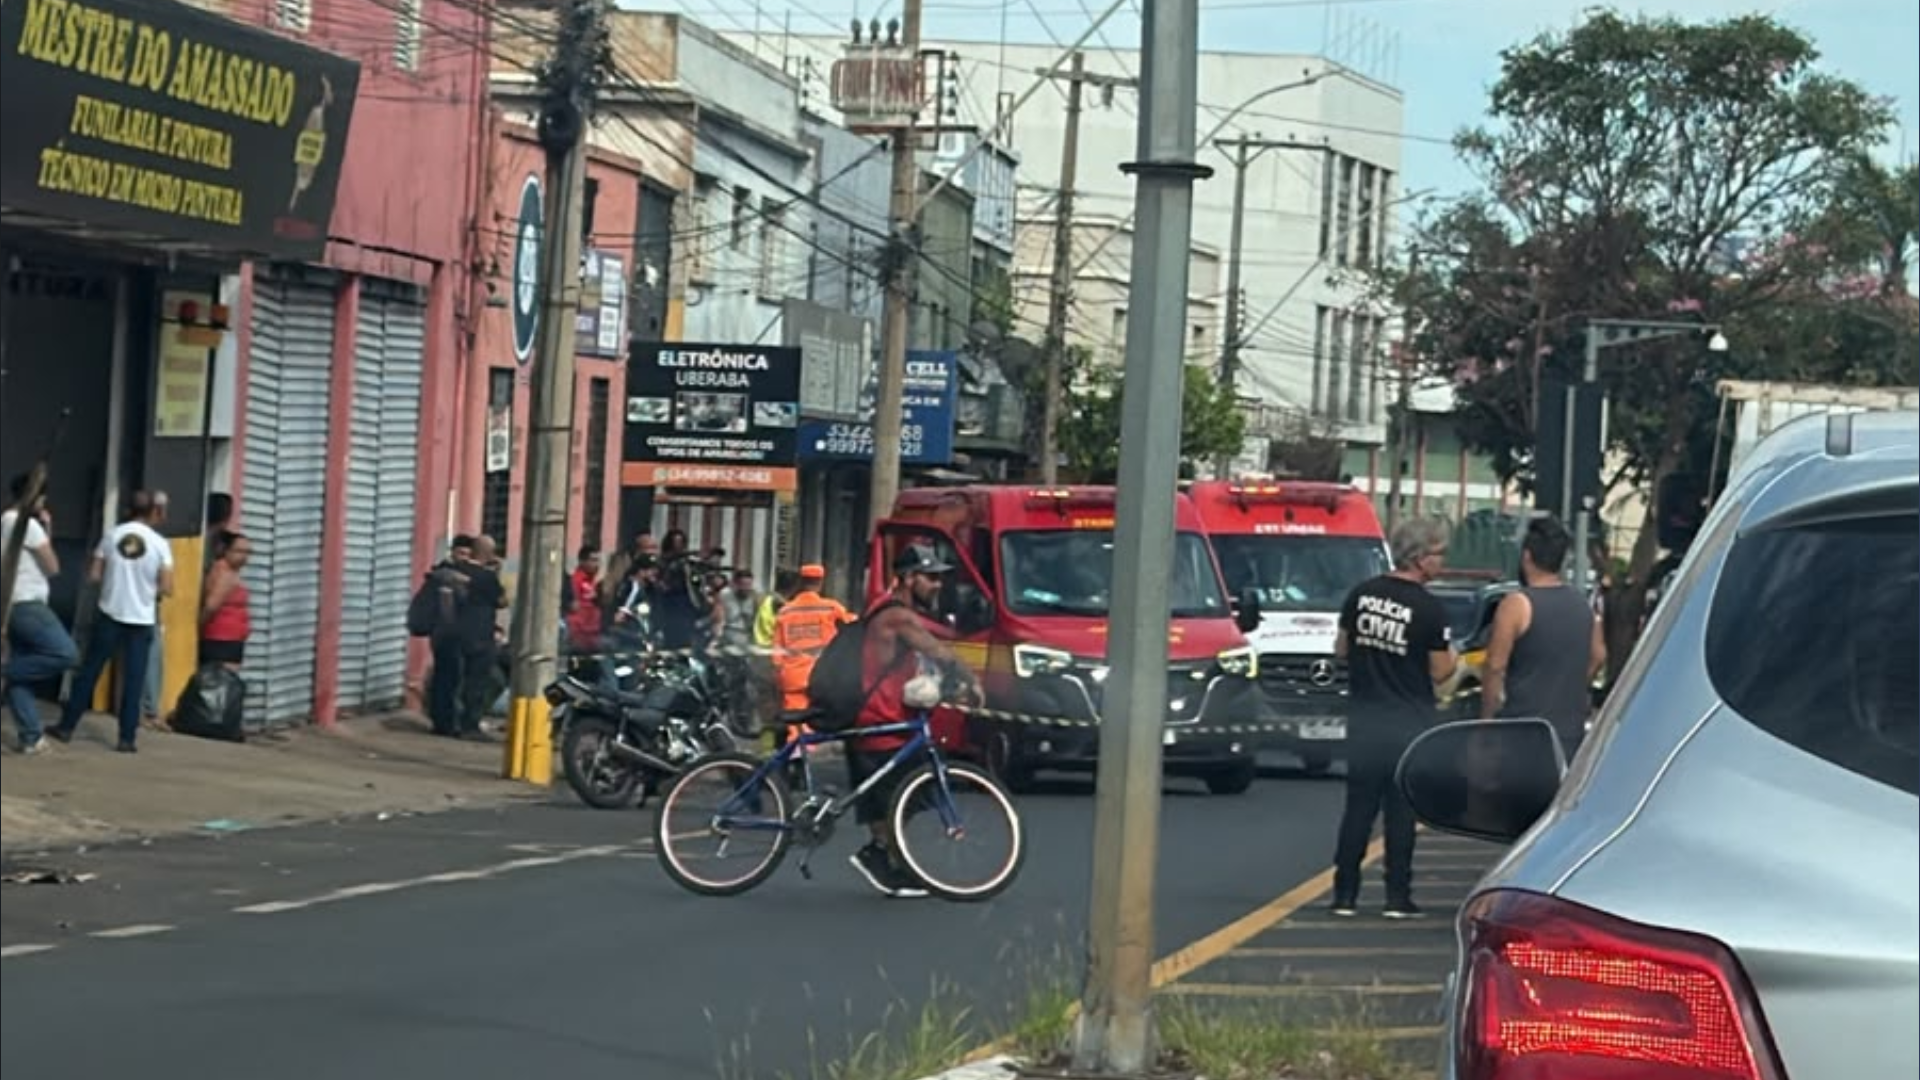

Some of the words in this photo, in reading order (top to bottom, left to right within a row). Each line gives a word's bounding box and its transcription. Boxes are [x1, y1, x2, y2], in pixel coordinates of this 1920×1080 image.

[17, 0, 133, 81] MESTRE
[128, 25, 170, 92] DO
[167, 39, 296, 127] AMASSADO
[70, 94, 158, 151] FUNILARIA
[156, 117, 172, 154] E
[169, 120, 232, 170] PINTURA
[38, 138, 110, 199] TÉCNICO
[107, 162, 136, 203] EM
[133, 169, 181, 213] MICRO
[179, 179, 243, 225] PINTURA
[658, 348, 769, 370] ELETRÔNICA
[906, 361, 948, 377] CELL
[676, 371, 750, 388] UBERABA
[1357, 595, 1412, 623] POLÍCIA
[1356, 613, 1408, 646] CIVIL
